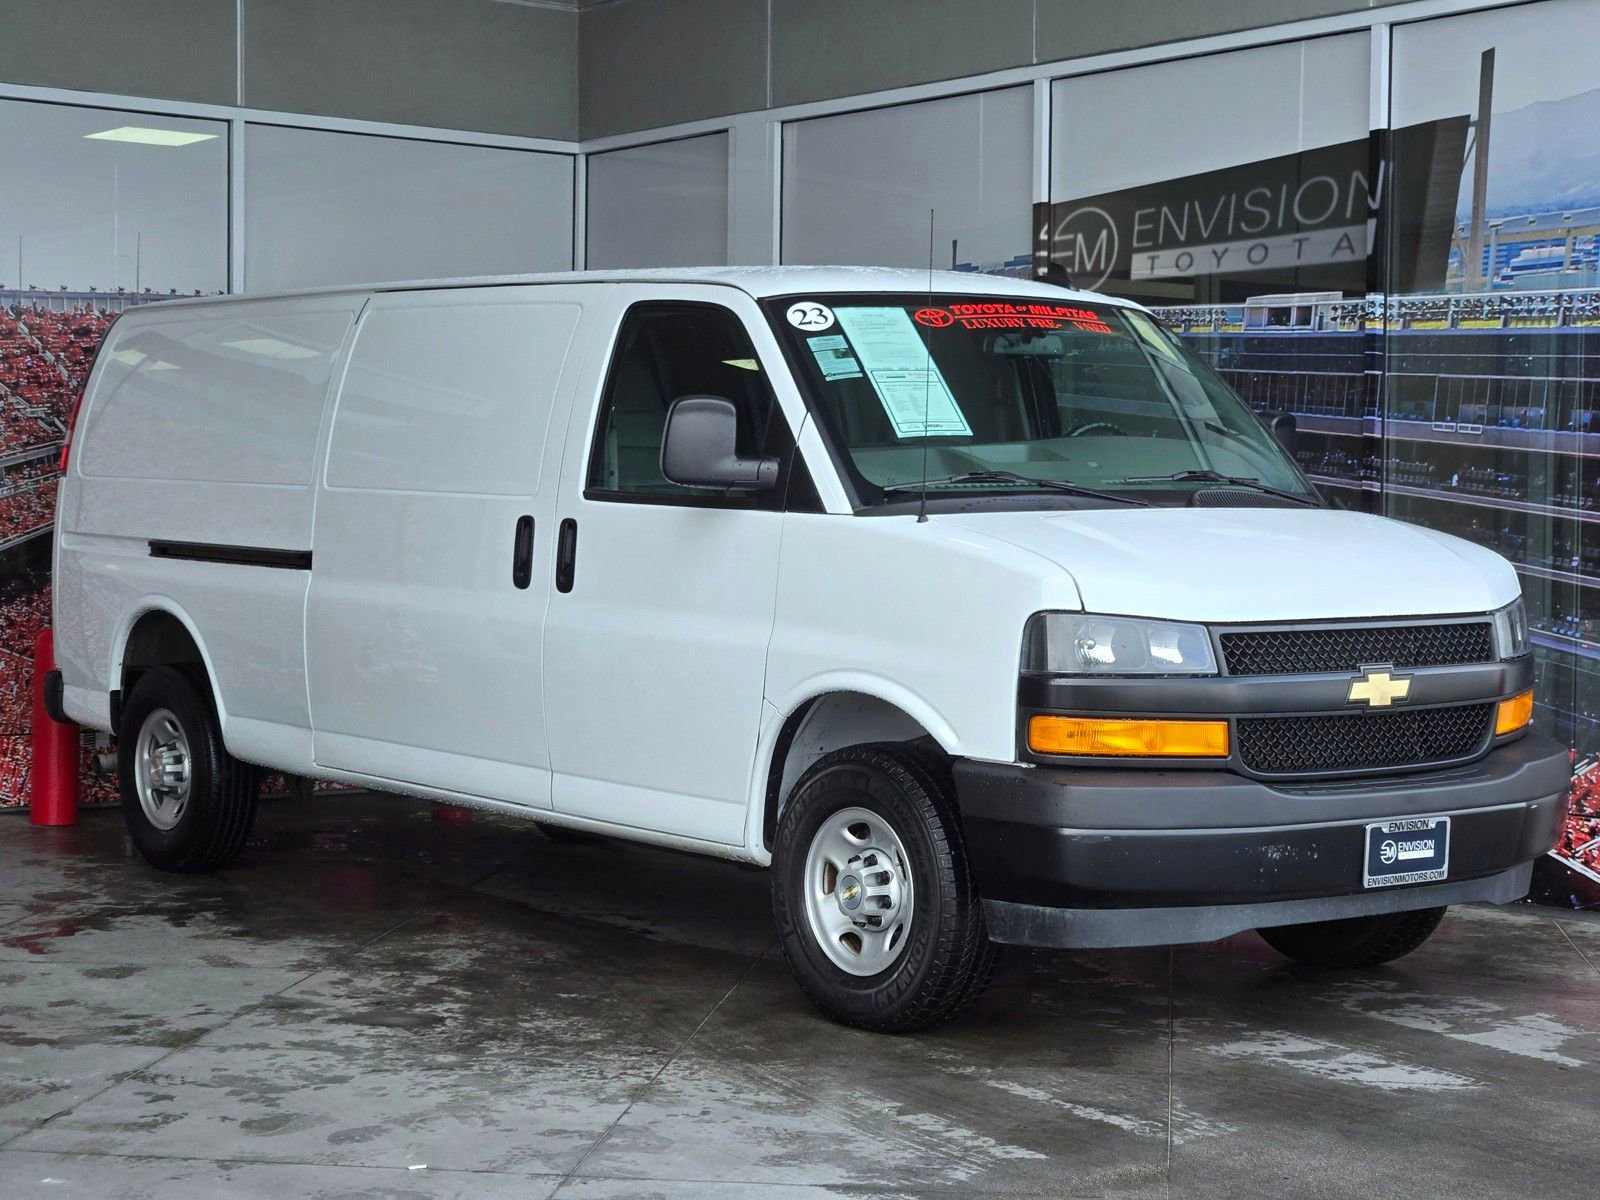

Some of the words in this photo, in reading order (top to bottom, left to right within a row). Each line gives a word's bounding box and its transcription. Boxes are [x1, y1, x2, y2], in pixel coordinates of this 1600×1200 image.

[1132, 160, 1385, 248] ENVISION
[1147, 232, 1355, 274] TOYOTA
[792, 307, 828, 326] 23
[950, 303, 1017, 315] TOYOTA
[1028, 305, 1098, 320] MILPITAS
[961, 318, 1027, 329] LUXURY
[1389, 820, 1429, 832] ENVISION
[1398, 840, 1434, 851] ENVISION
[1368, 871, 1444, 886] ENVISIONMOTORS.COM
